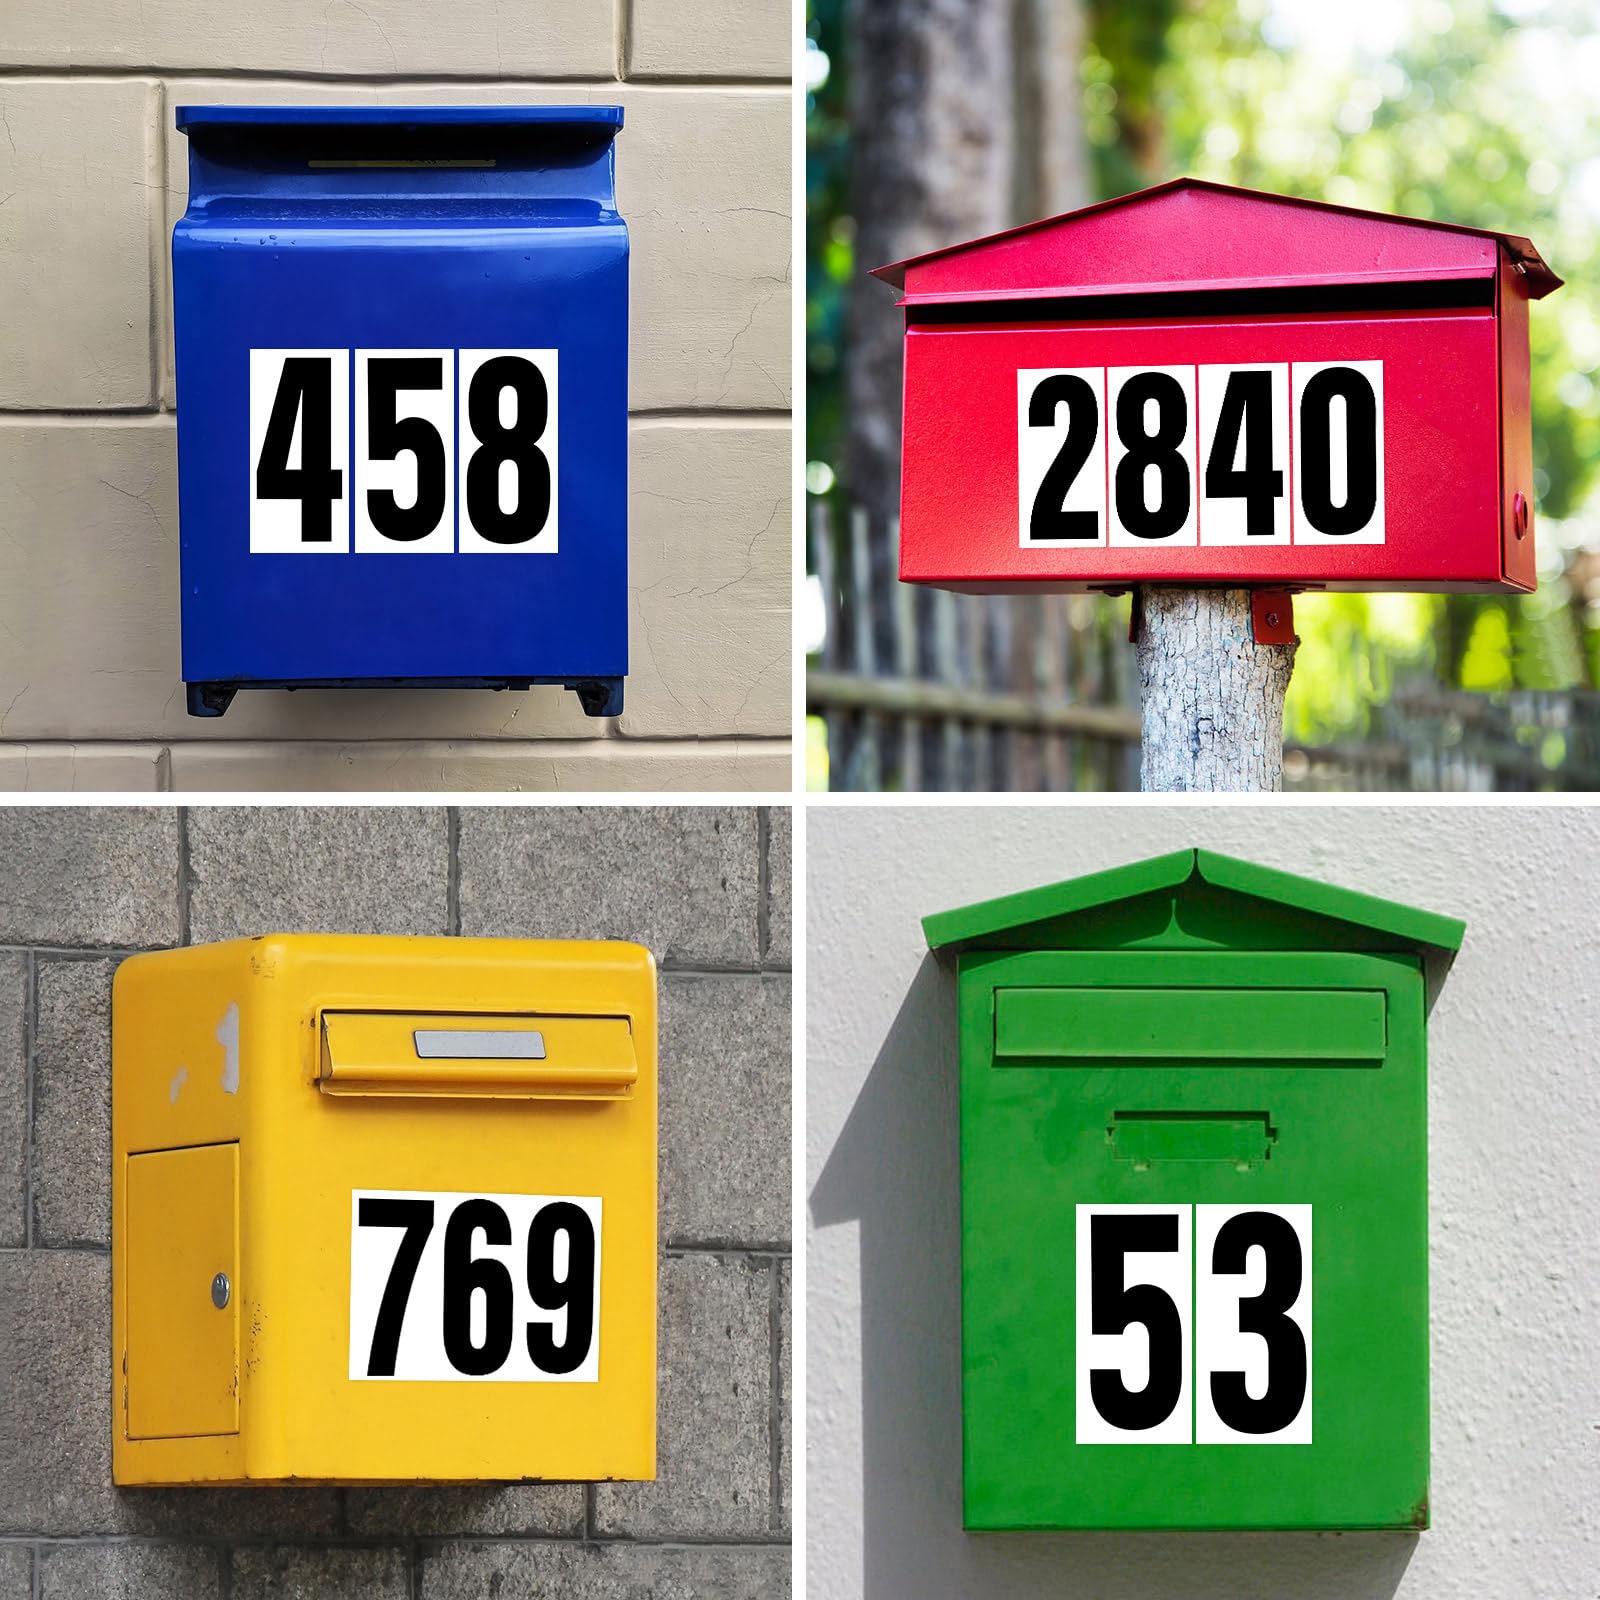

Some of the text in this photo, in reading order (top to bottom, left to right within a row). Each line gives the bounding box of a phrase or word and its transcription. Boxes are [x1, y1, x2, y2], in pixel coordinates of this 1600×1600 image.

[256, 356, 551, 545] 458
[1028, 366, 1377, 540] 2840
[358, 1198, 595, 1377] 769
[1089, 1211, 1307, 1435] 53
